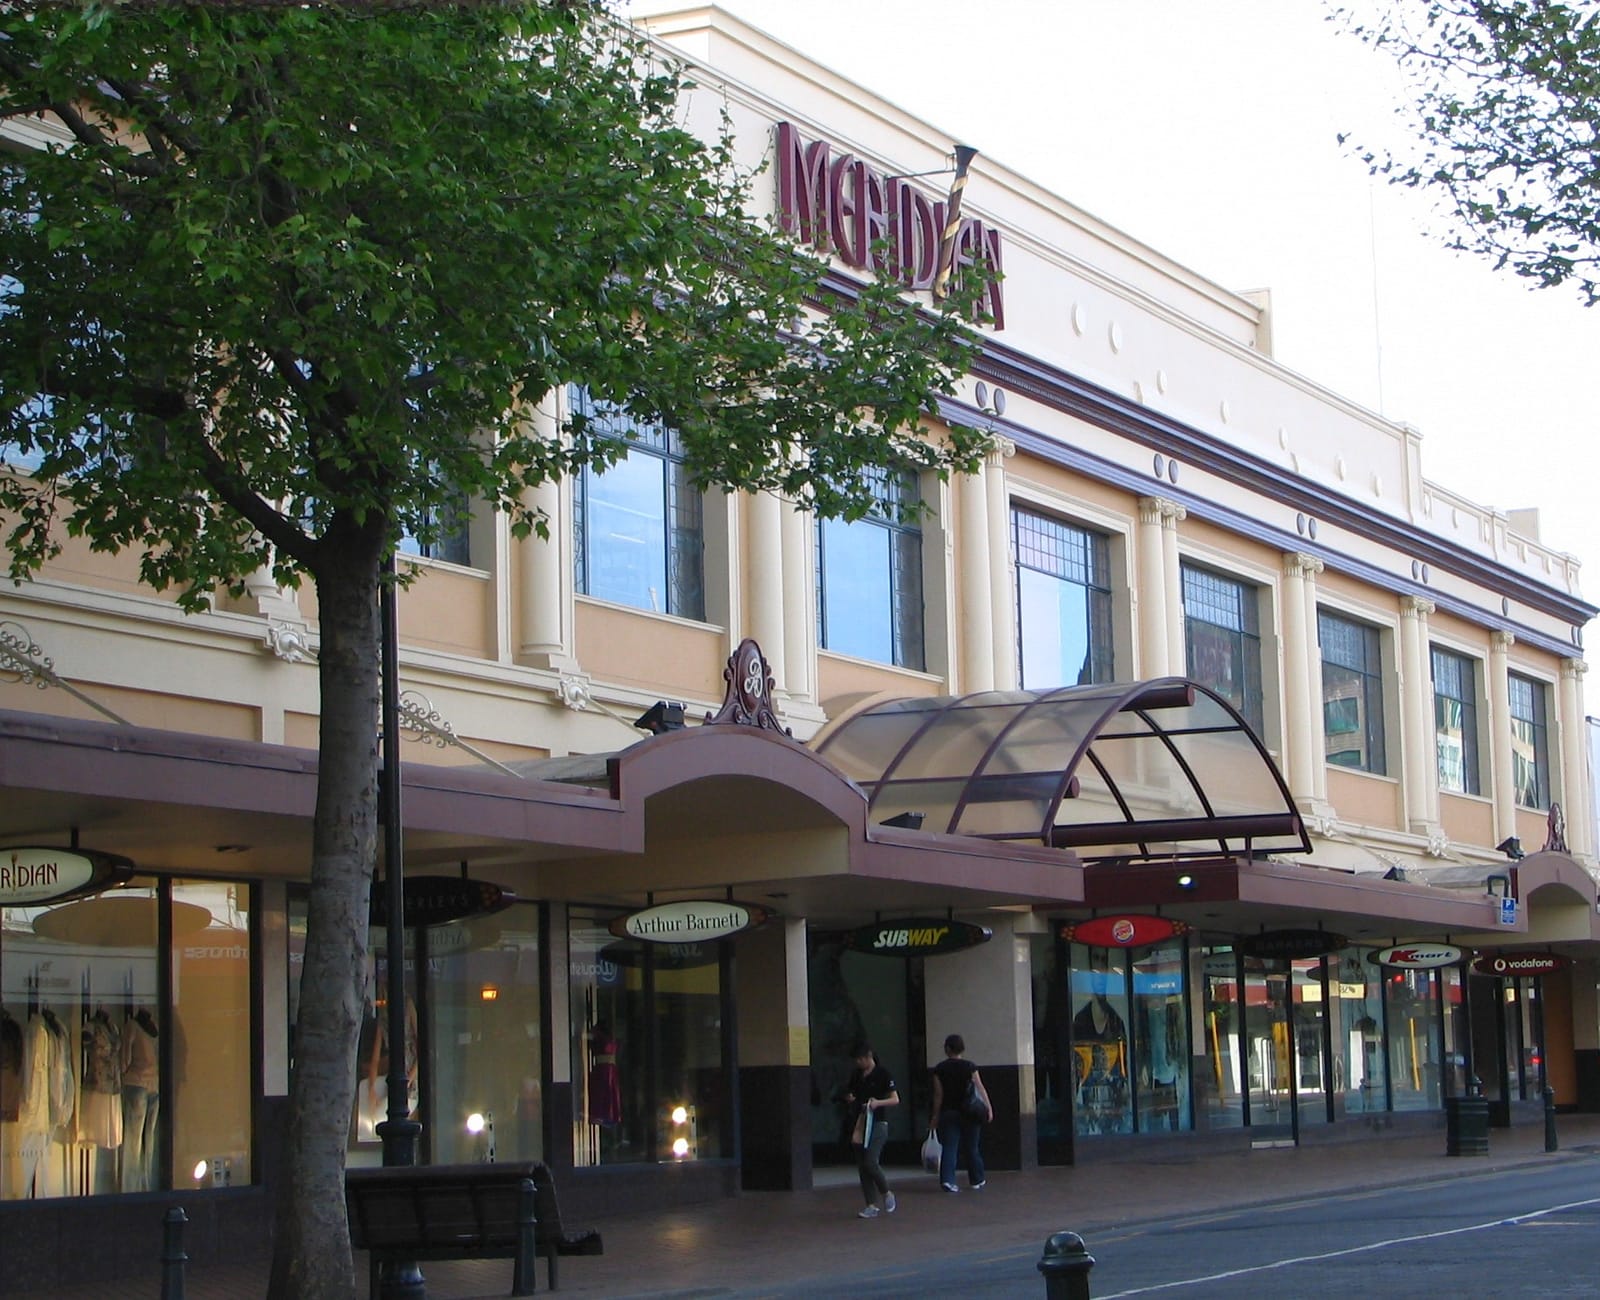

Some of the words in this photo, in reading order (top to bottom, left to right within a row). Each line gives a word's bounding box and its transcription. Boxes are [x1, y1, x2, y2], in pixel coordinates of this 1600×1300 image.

[633, 917, 681, 934] Arthur
[686, 912, 740, 931] Barnett
[873, 928, 949, 948] SUBWAY
[1389, 949, 1453, 963] Kmart
[1508, 959, 1554, 969] vodafone
